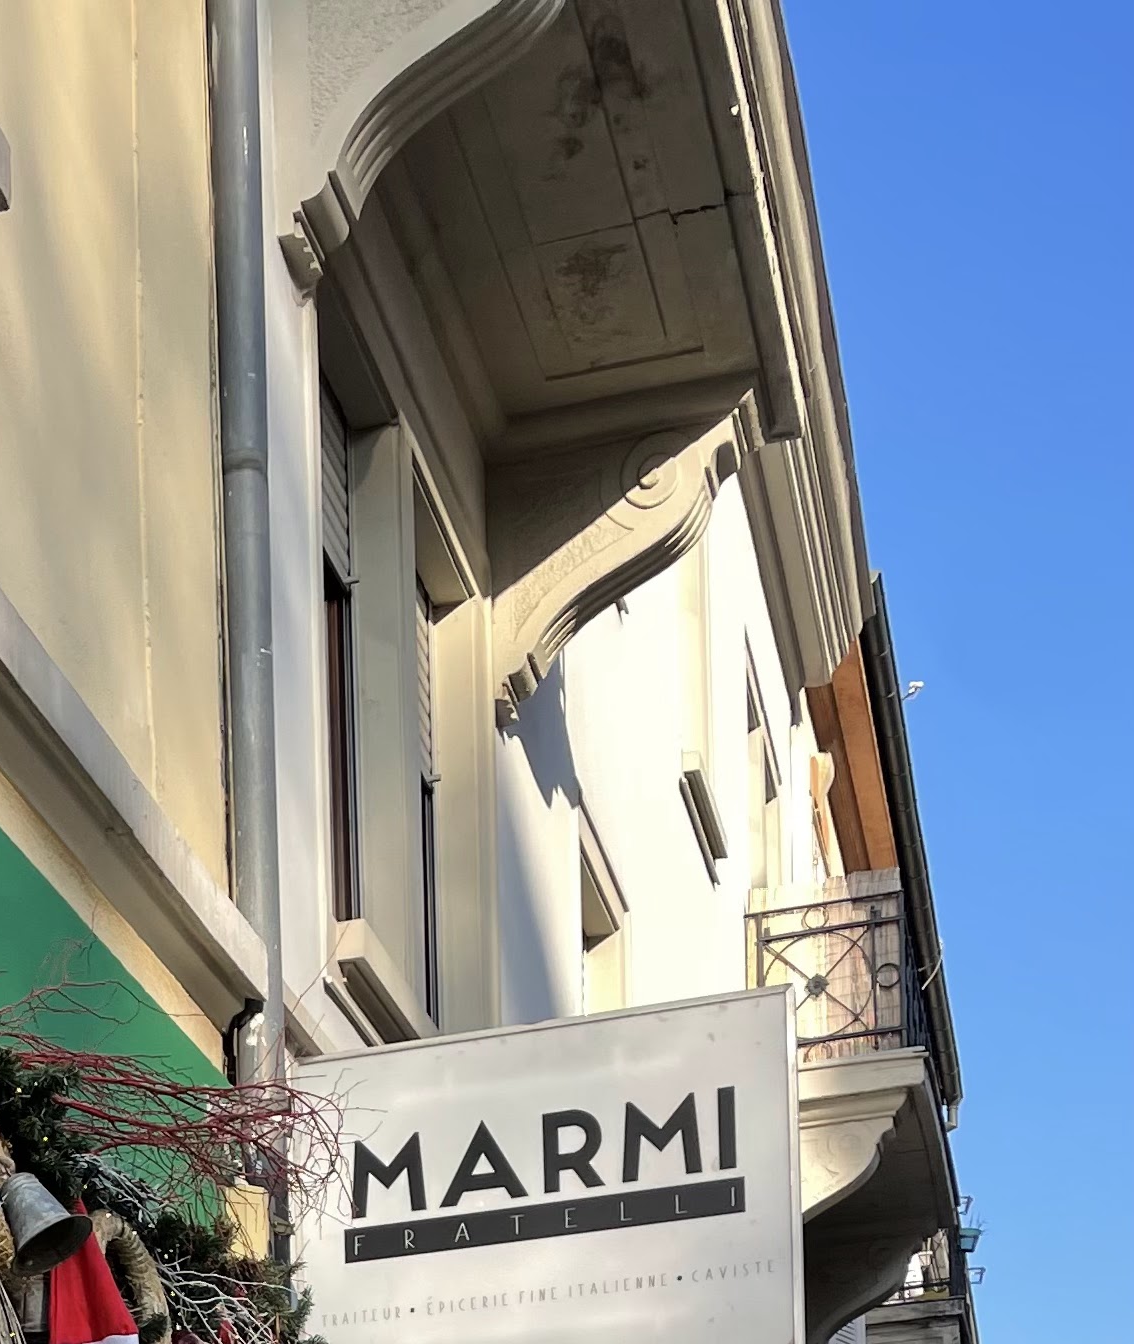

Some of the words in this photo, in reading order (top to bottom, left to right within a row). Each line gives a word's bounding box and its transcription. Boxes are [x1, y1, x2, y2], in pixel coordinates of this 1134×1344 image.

[352, 1085, 737, 1219] MARMI
[354, 1187, 736, 1257] FRATELLI
[321, 1308, 402, 1328] TRAITEUR
[426, 1295, 509, 1317] ÉPICERIE
[519, 1284, 558, 1305] FINE
[568, 1273, 669, 1298] ITALIENNE
[691, 1259, 776, 1284] CAVISTE
